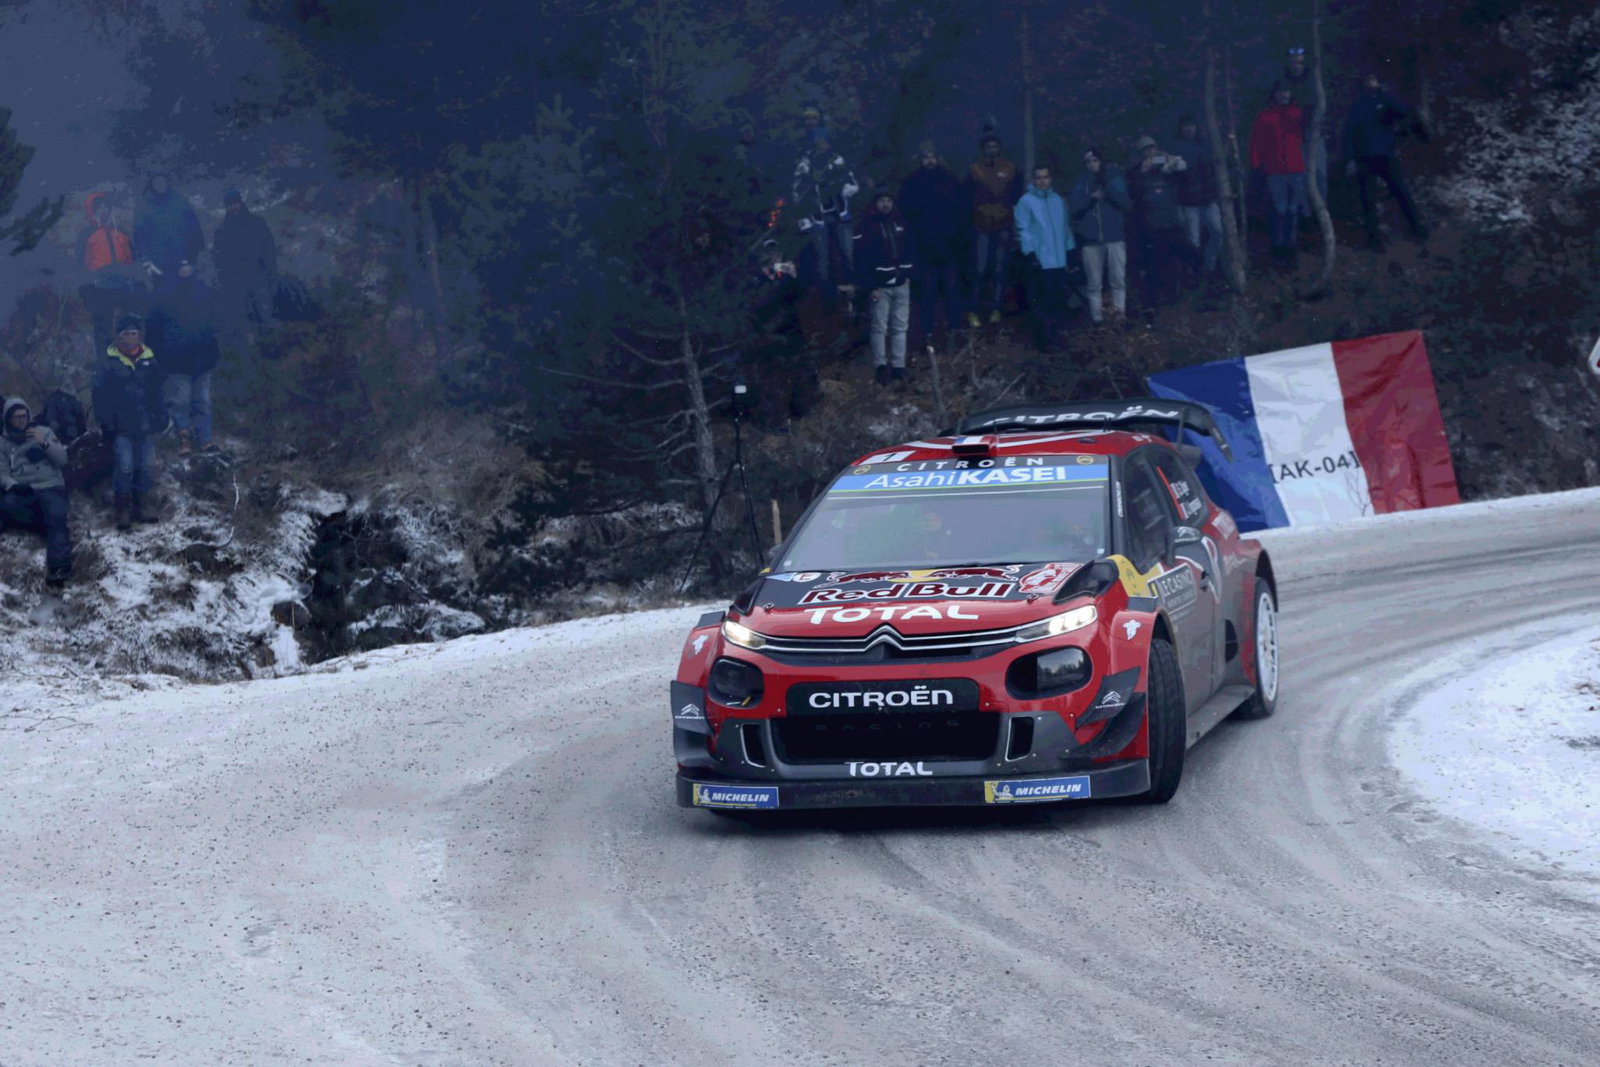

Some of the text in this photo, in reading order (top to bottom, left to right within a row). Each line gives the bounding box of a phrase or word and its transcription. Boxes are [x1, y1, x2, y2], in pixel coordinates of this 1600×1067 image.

[983, 405, 1179, 426] CITROËN
[896, 456, 1043, 472] CITROËN
[1268, 451, 1361, 484] [AK-04]
[798, 581, 1015, 605] Red Bull
[804, 605, 979, 625] TOTAL
[809, 685, 954, 708] CITROËN
[844, 761, 933, 777] TOTAL
[711, 792, 770, 803] MICHELIN
[1015, 783, 1082, 796] MICHELIN
